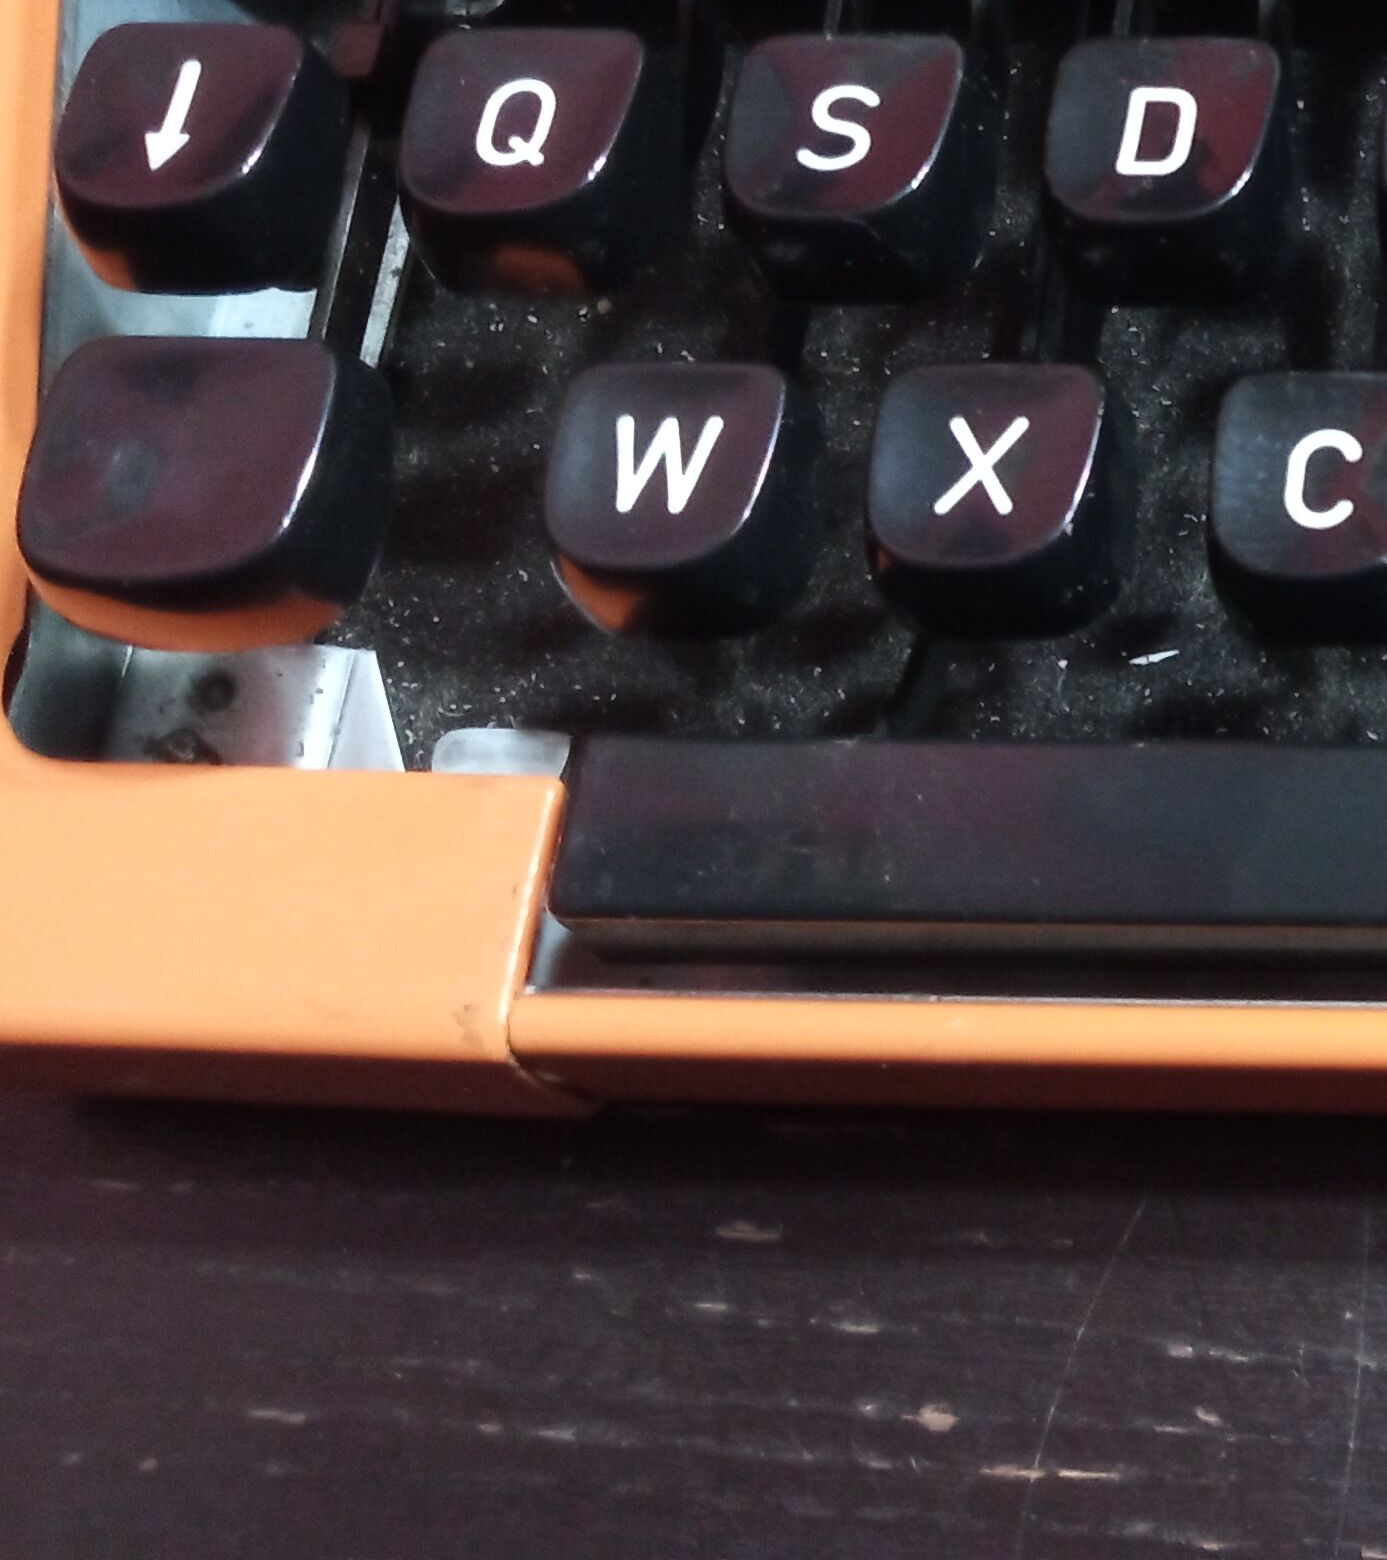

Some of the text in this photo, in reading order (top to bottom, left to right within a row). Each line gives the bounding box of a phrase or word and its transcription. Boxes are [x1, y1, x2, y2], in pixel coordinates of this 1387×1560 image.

[474, 76, 558, 168] Q
[795, 83, 882, 172] S
[1114, 85, 1199, 177] D
[614, 413, 725, 516] W
[932, 415, 1031, 516] X
[1282, 427, 1364, 531] C
